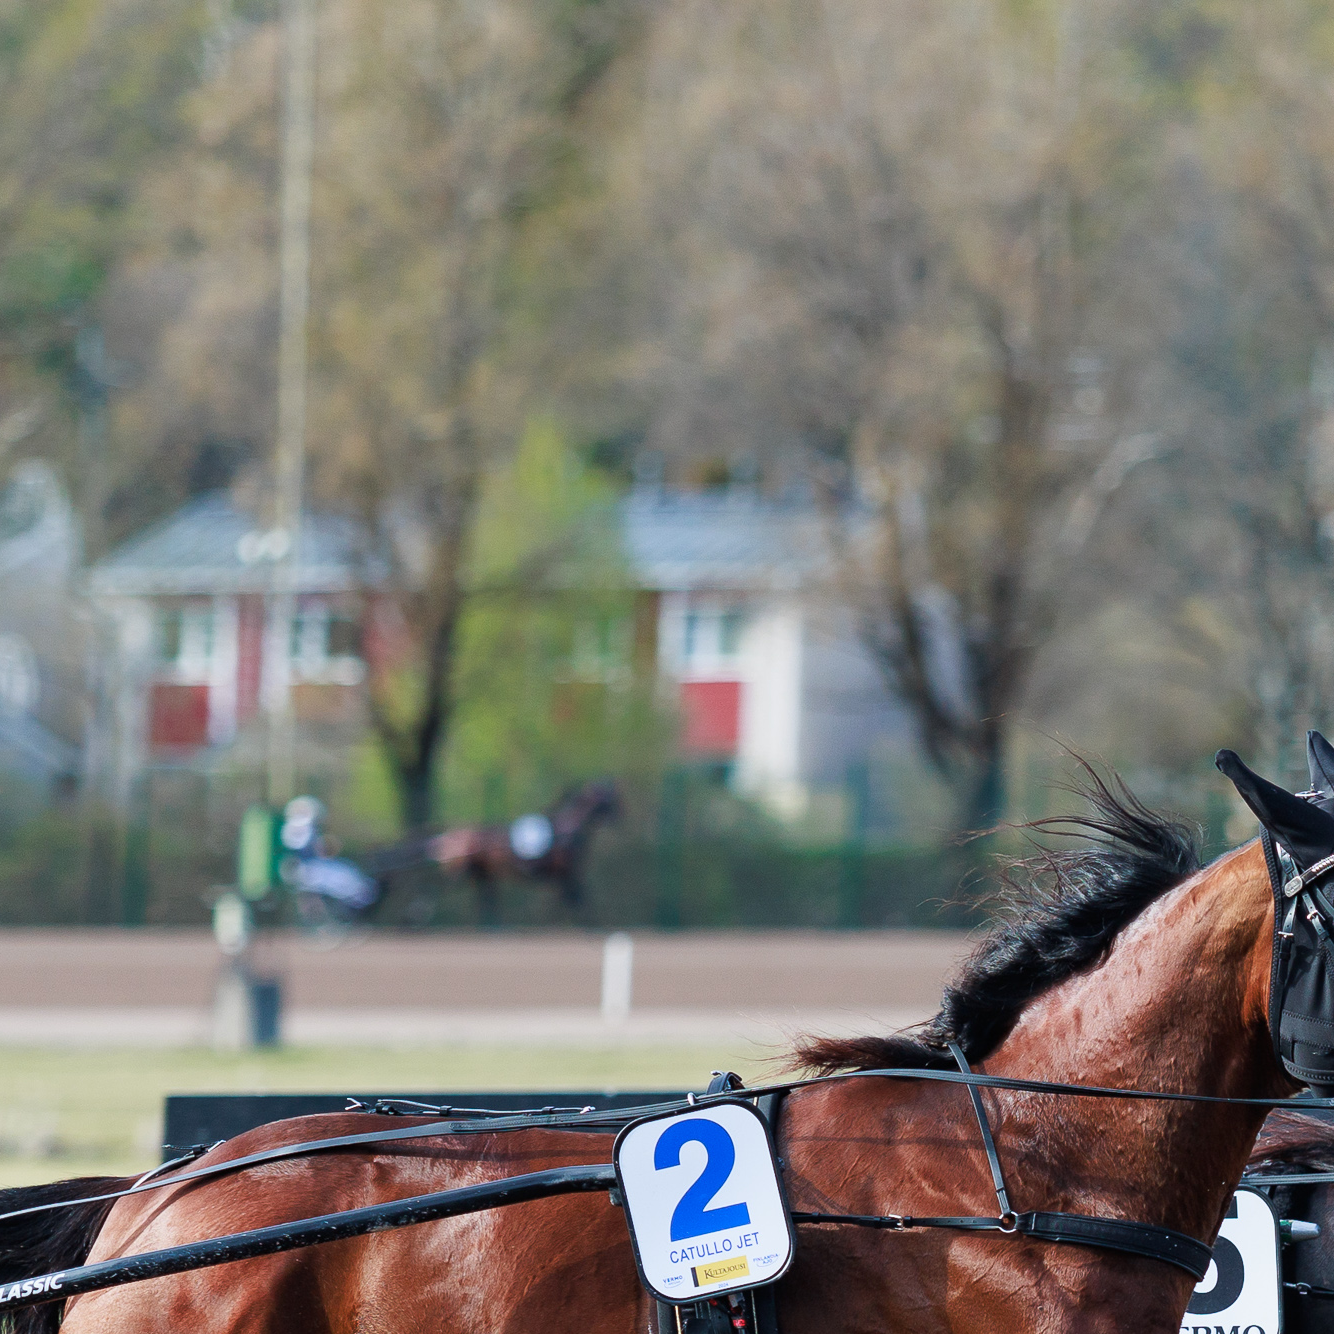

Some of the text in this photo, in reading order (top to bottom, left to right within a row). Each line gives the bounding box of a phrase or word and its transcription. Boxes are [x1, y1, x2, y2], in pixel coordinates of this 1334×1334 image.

[654, 1118, 751, 1242] 2
[669, 1232, 760, 1264] CATULLO JET
[663, 1275, 684, 1284] VERMO
[704, 1262, 746, 1279] KULTAJOUSI
